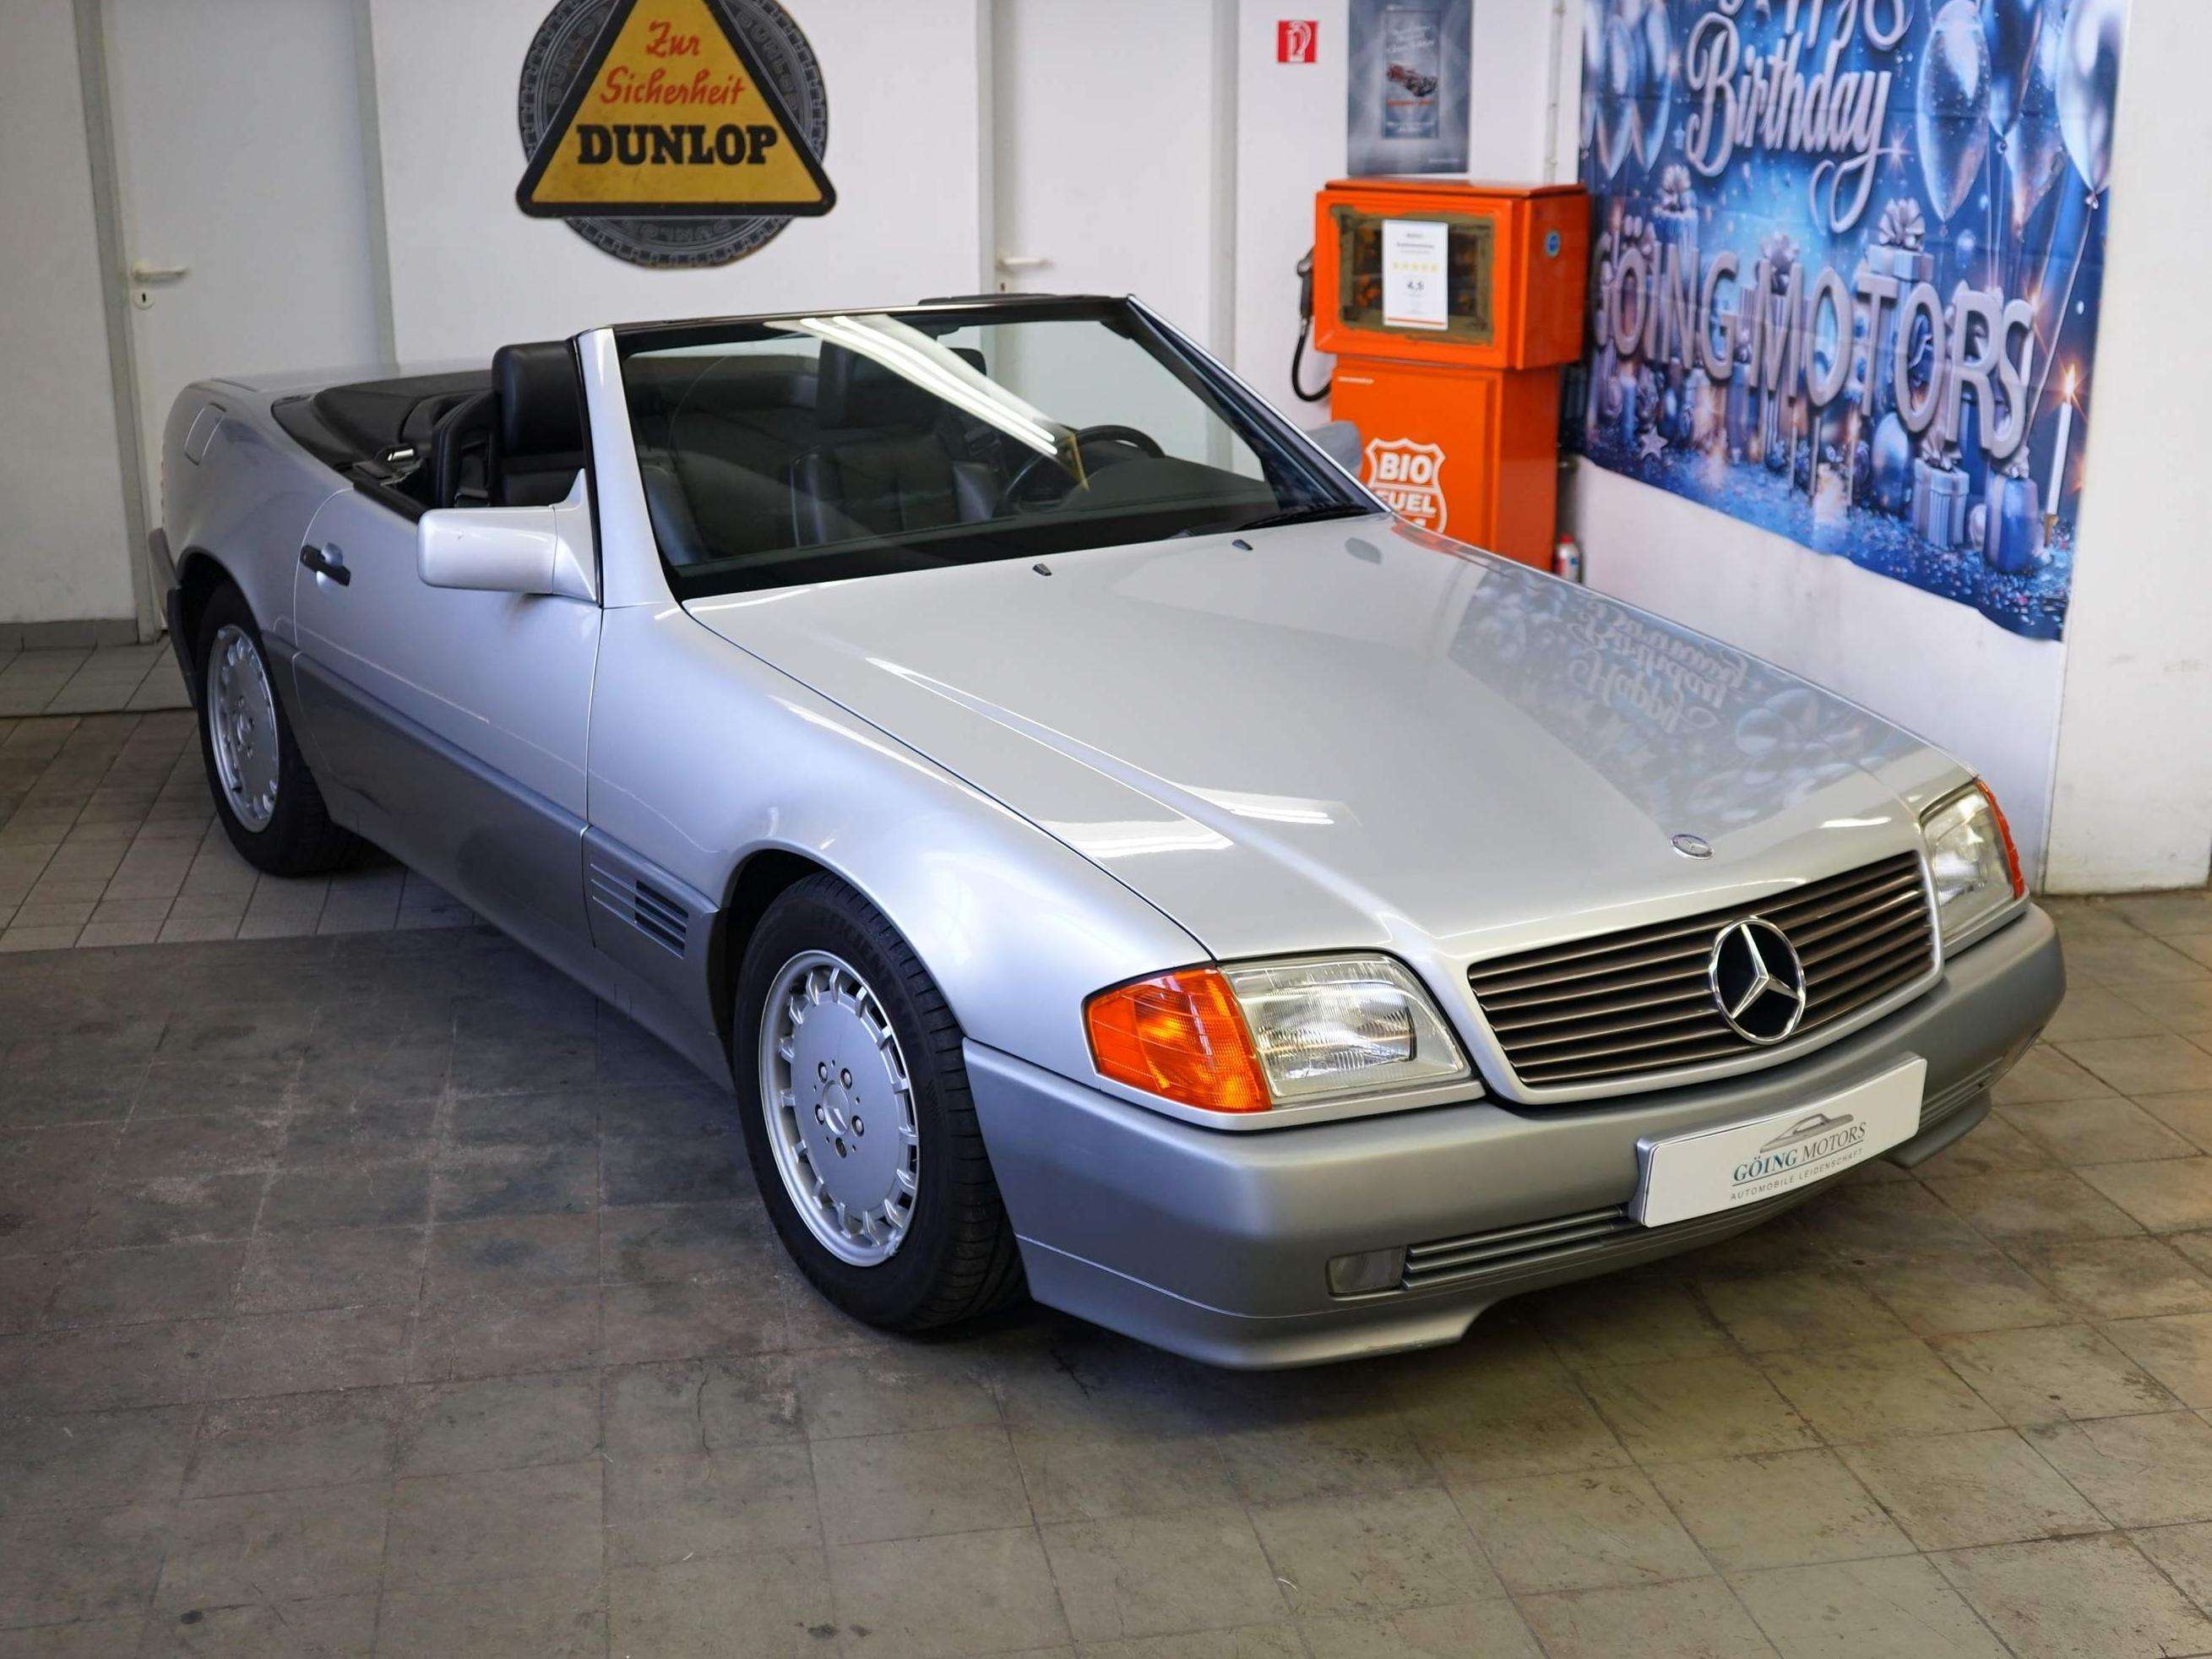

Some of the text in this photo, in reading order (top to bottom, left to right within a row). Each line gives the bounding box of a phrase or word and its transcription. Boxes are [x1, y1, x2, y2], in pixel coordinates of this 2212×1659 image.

[645, 19, 699, 57] Zur
[599, 65, 743, 105] Sicherheit
[576, 123, 777, 166] DUNLOP
[1685, 12, 1892, 234] Birthday
[1748, 257, 2035, 460] MOTORS
[1378, 451, 1433, 485] BIO
[1730, 1147, 1863, 1200] AUTOMOBILE LEIDENSCHAFT
[1733, 1122, 1867, 1182] GÖING MOTORS
